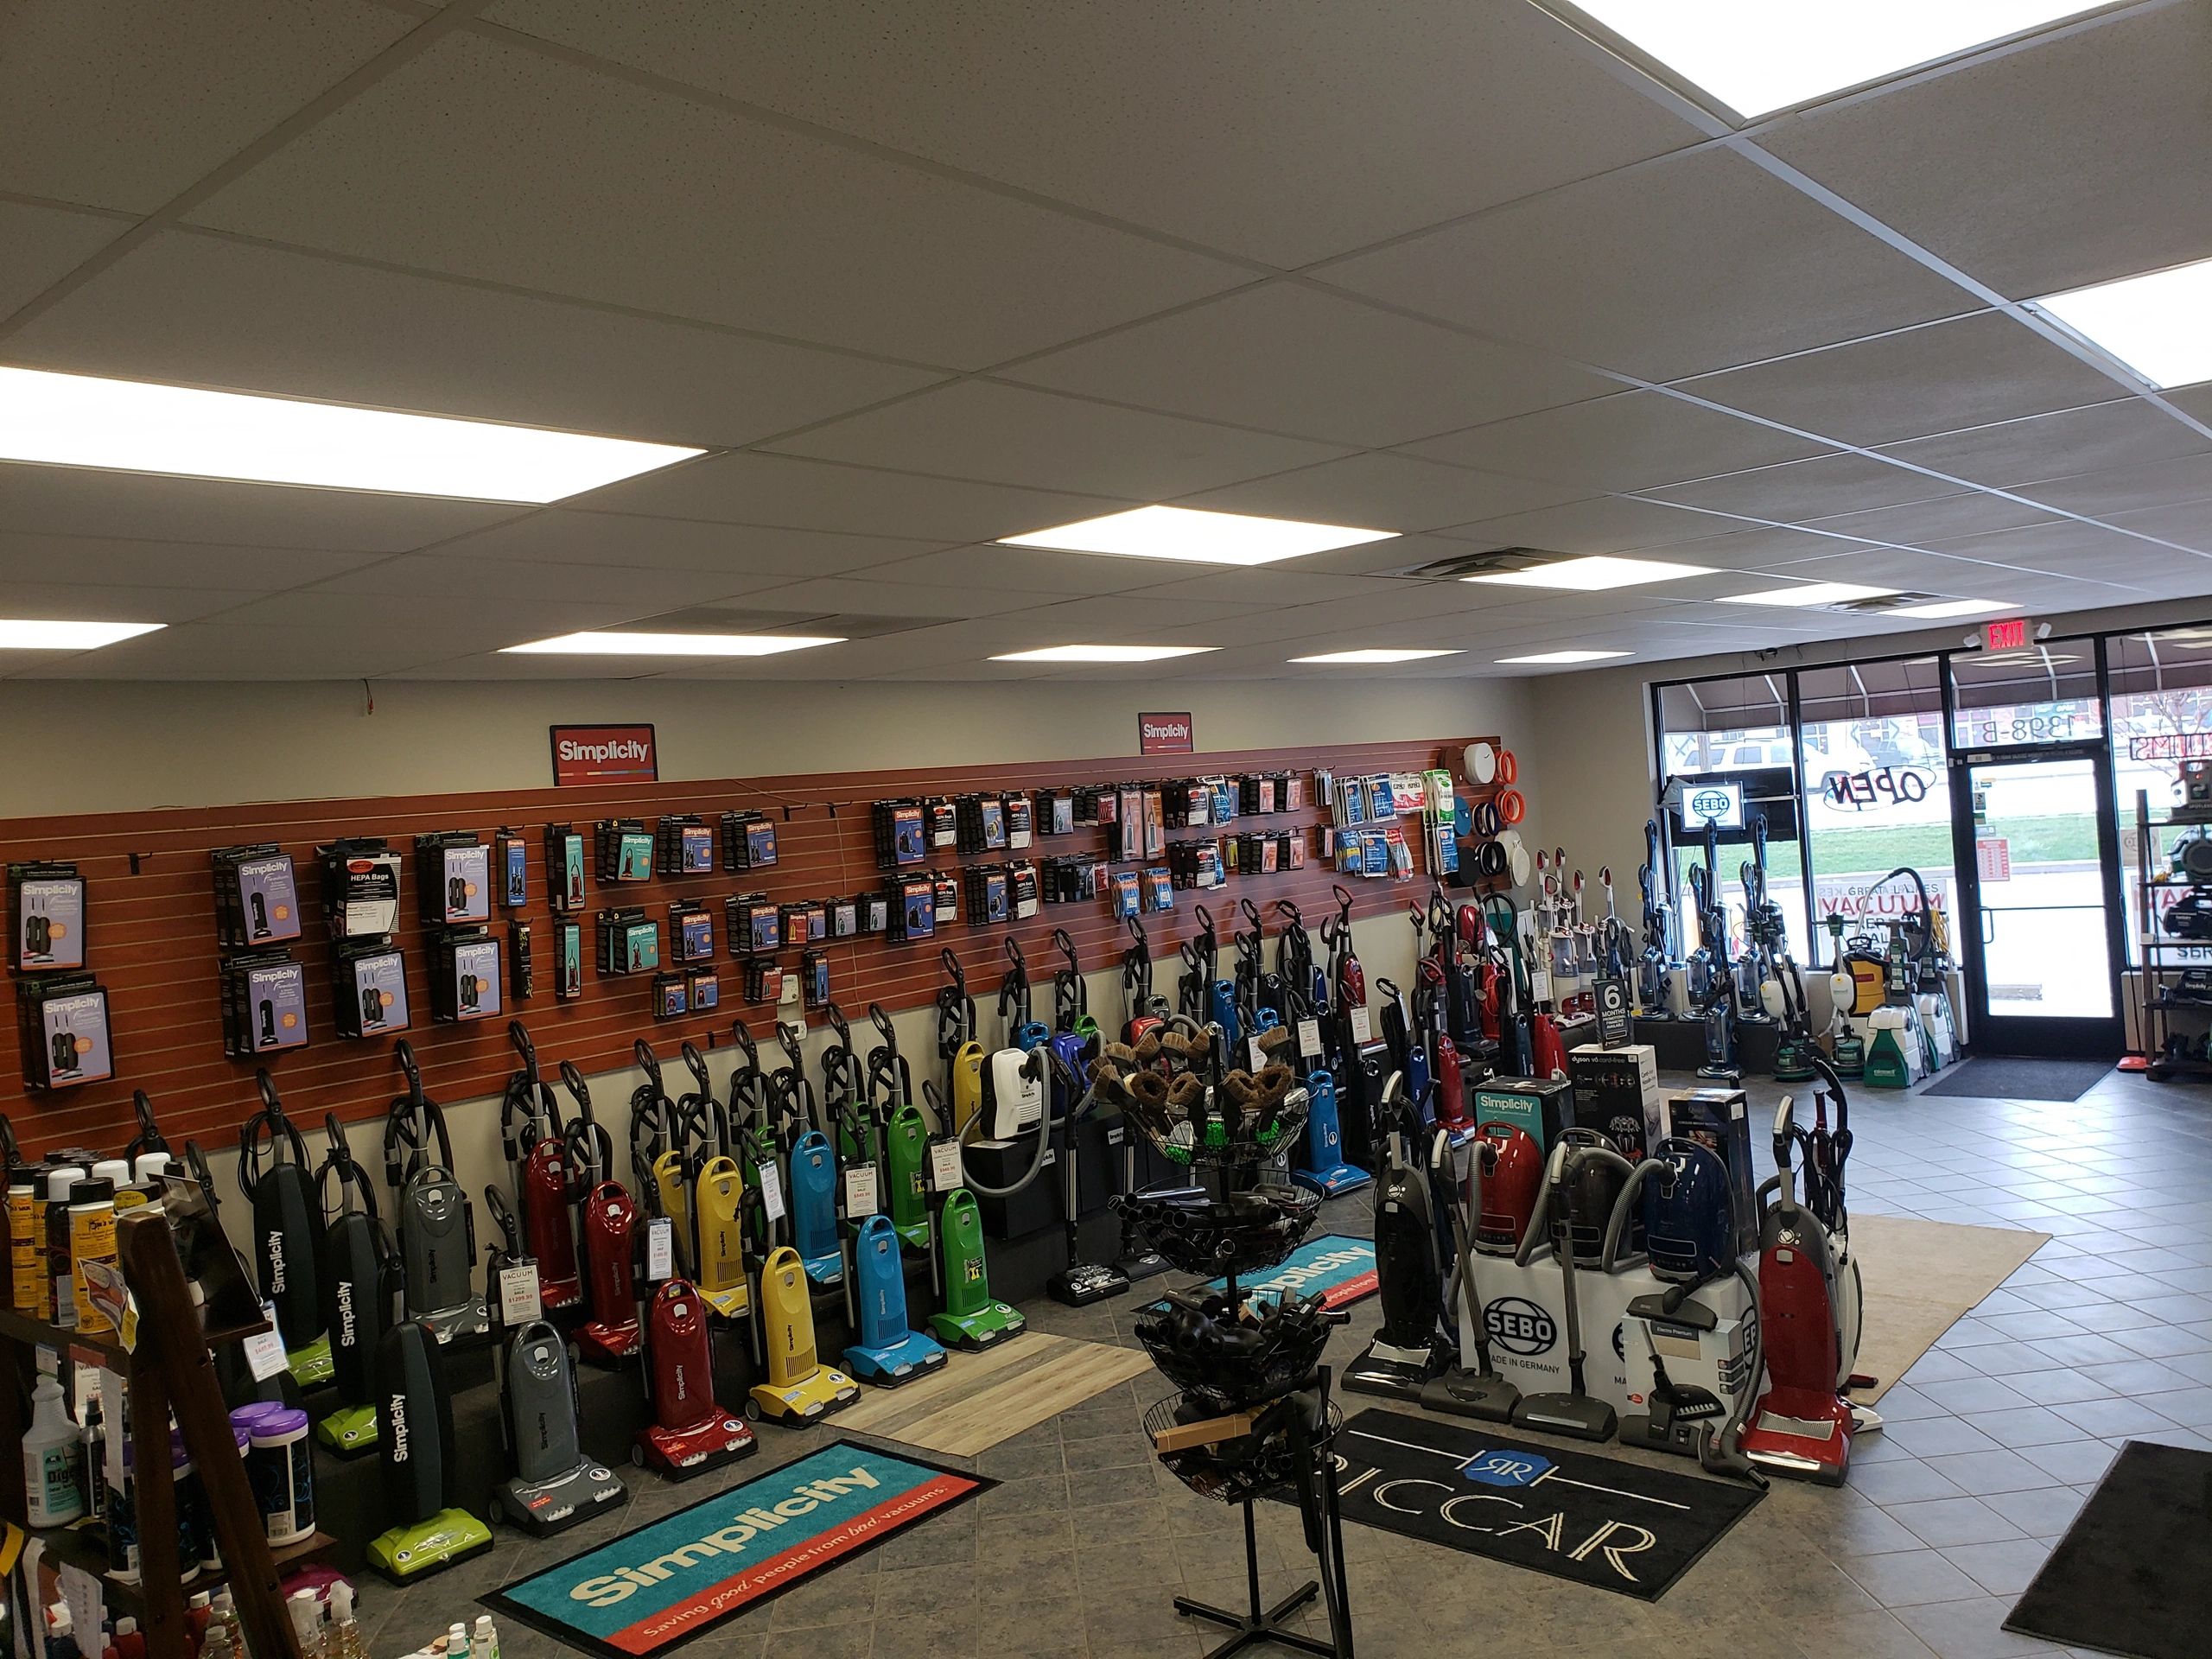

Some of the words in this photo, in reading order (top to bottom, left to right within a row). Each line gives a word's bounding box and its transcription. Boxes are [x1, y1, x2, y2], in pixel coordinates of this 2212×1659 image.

[1988, 620, 2025, 650] EXIT
[1143, 723, 1189, 741] Simplicity
[559, 740, 648, 764] Simplicity
[1694, 798, 1728, 810] SEBO
[896, 810, 920, 819] Simplicity
[747, 823, 772, 831] Simplicity
[623, 836, 652, 845] Simplicity
[446, 850, 484, 861] Simplicity
[242, 861, 288, 875] Simplicity
[22, 885, 78, 896] Simplicity
[906, 885, 931, 893] Simplicity
[752, 906, 777, 915] Simplicity
[1821, 893, 1944, 917] VACUUM
[683, 914, 709, 924] Simplicity
[628, 926, 655, 937] Simplicity
[457, 946, 495, 957] Simplicity
[356, 957, 398, 971] Simplicity
[251, 969, 298, 982] Simplicity
[1604, 984, 1621, 1009] 6
[45, 997, 99, 1014] Simplicity
[1602, 1007, 1625, 1018] MONTHS
[1021, 1090, 1035, 1099] Simplicity
[1480, 1095, 1534, 1113] Simplicity
[934, 1146, 957, 1154] VACUUM
[268, 1230, 286, 1294] Simplicity
[503, 1270, 533, 1281] VACUUM
[337, 1281, 356, 1348] Simplicity
[1487, 1312, 1552, 1341] SEBO
[1491, 1354, 1507, 1365] ADE
[1509, 1357, 1518, 1367] IN
[1519, 1359, 1560, 1374] GERMANY
[1614, 1375, 1627, 1384] MA
[391, 1394, 410, 1463] Simplicity
[569, 1466, 881, 1607] Simplicity
[643, 1603, 710, 1639] Saving
[711, 1580, 752, 1611] good
[752, 1553, 811, 1586] people
[806, 1534, 848, 1561] from
